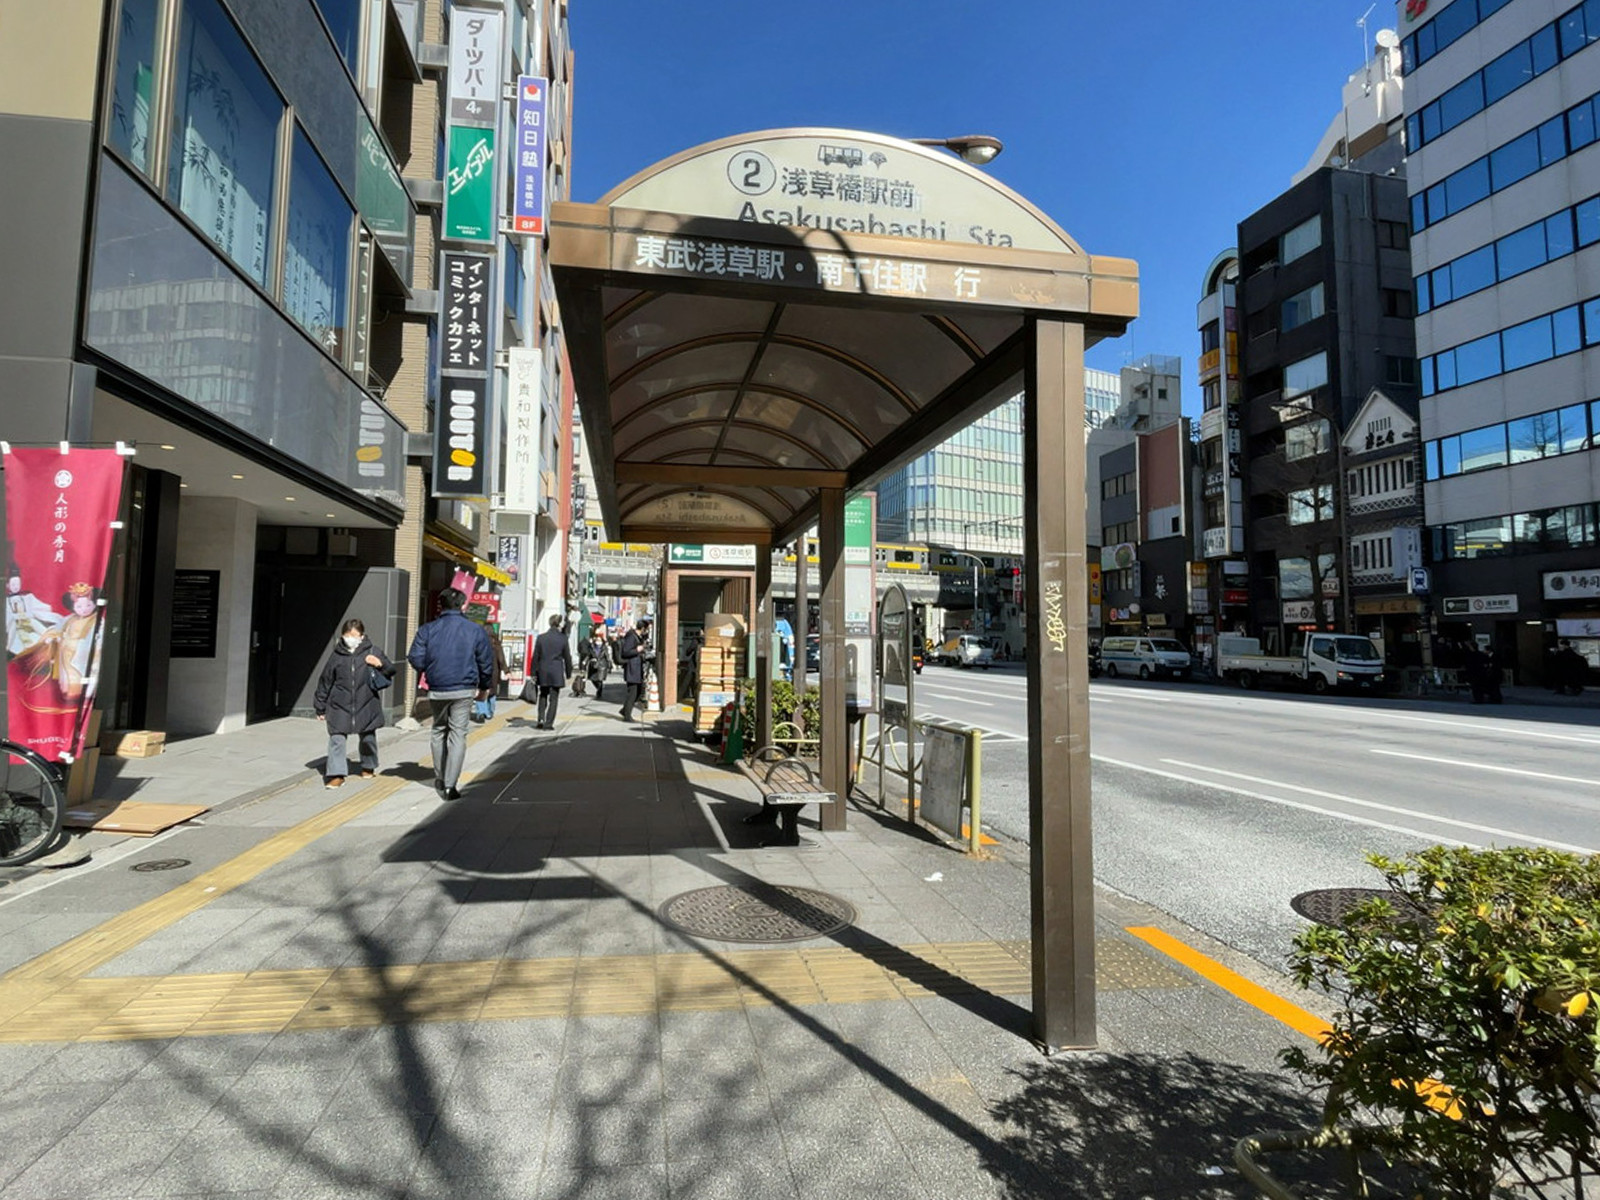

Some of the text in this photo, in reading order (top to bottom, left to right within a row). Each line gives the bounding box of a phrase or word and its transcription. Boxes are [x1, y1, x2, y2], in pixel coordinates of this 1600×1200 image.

[465, 18, 486, 98] ダーツバー
[447, 141, 494, 192] エイブル
[521, 109, 541, 169] 知日塾
[781, 166, 916, 209] 浅草橋駅前
[521, 220, 536, 229] 8F
[447, 261, 466, 364] コミックカフェ
[468, 261, 484, 366] インターネット
[953, 267, 981, 299] 行
[447, 389, 476, 482] DOUTOR
[53, 492, 69, 563] 人形の秀月
